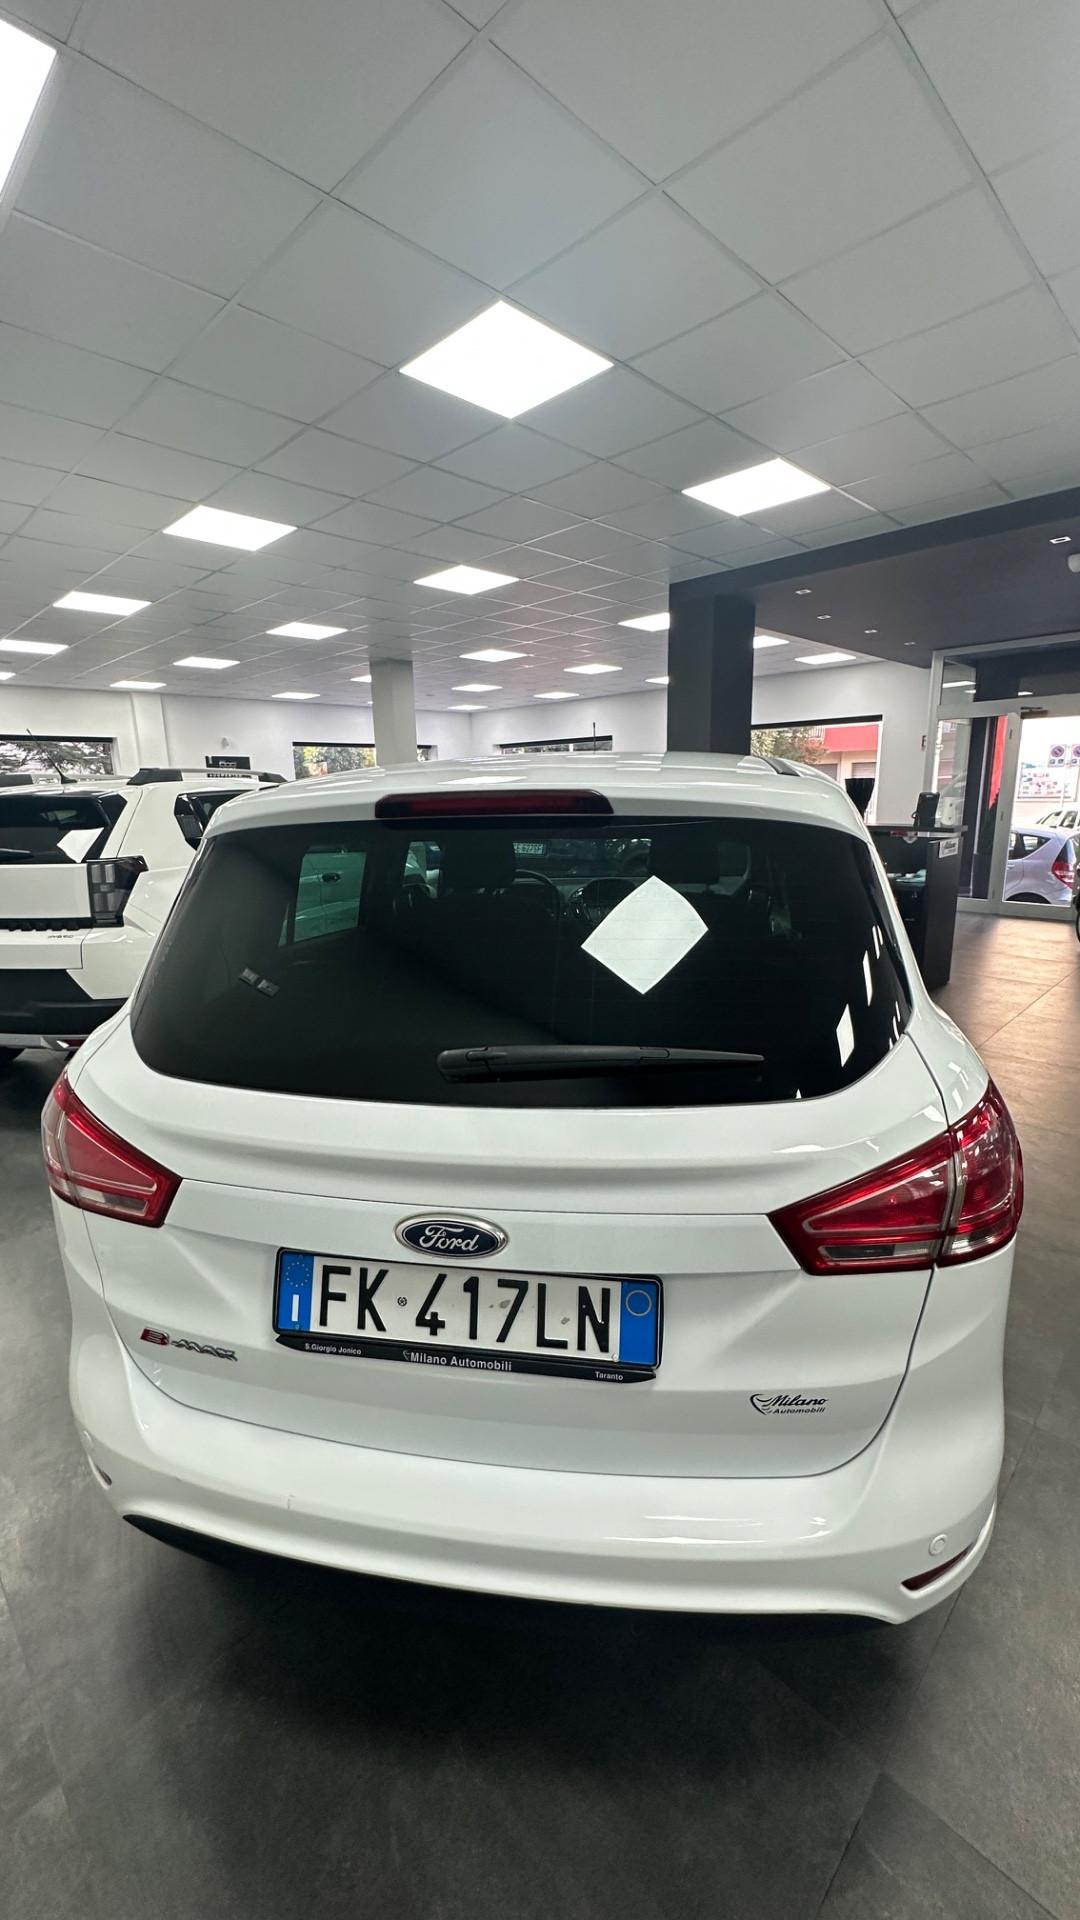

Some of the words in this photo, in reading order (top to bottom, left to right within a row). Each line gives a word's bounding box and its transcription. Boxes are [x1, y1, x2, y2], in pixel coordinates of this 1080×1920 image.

[419, 1225, 480, 1251] Ford
[338, 1346, 362, 1355] Jonico
[410, 1352, 447, 1365] Milano
[450, 1357, 512, 1371] Automobili
[595, 1371, 624, 1381] Taranto
[770, 1394, 828, 1407] Milano
